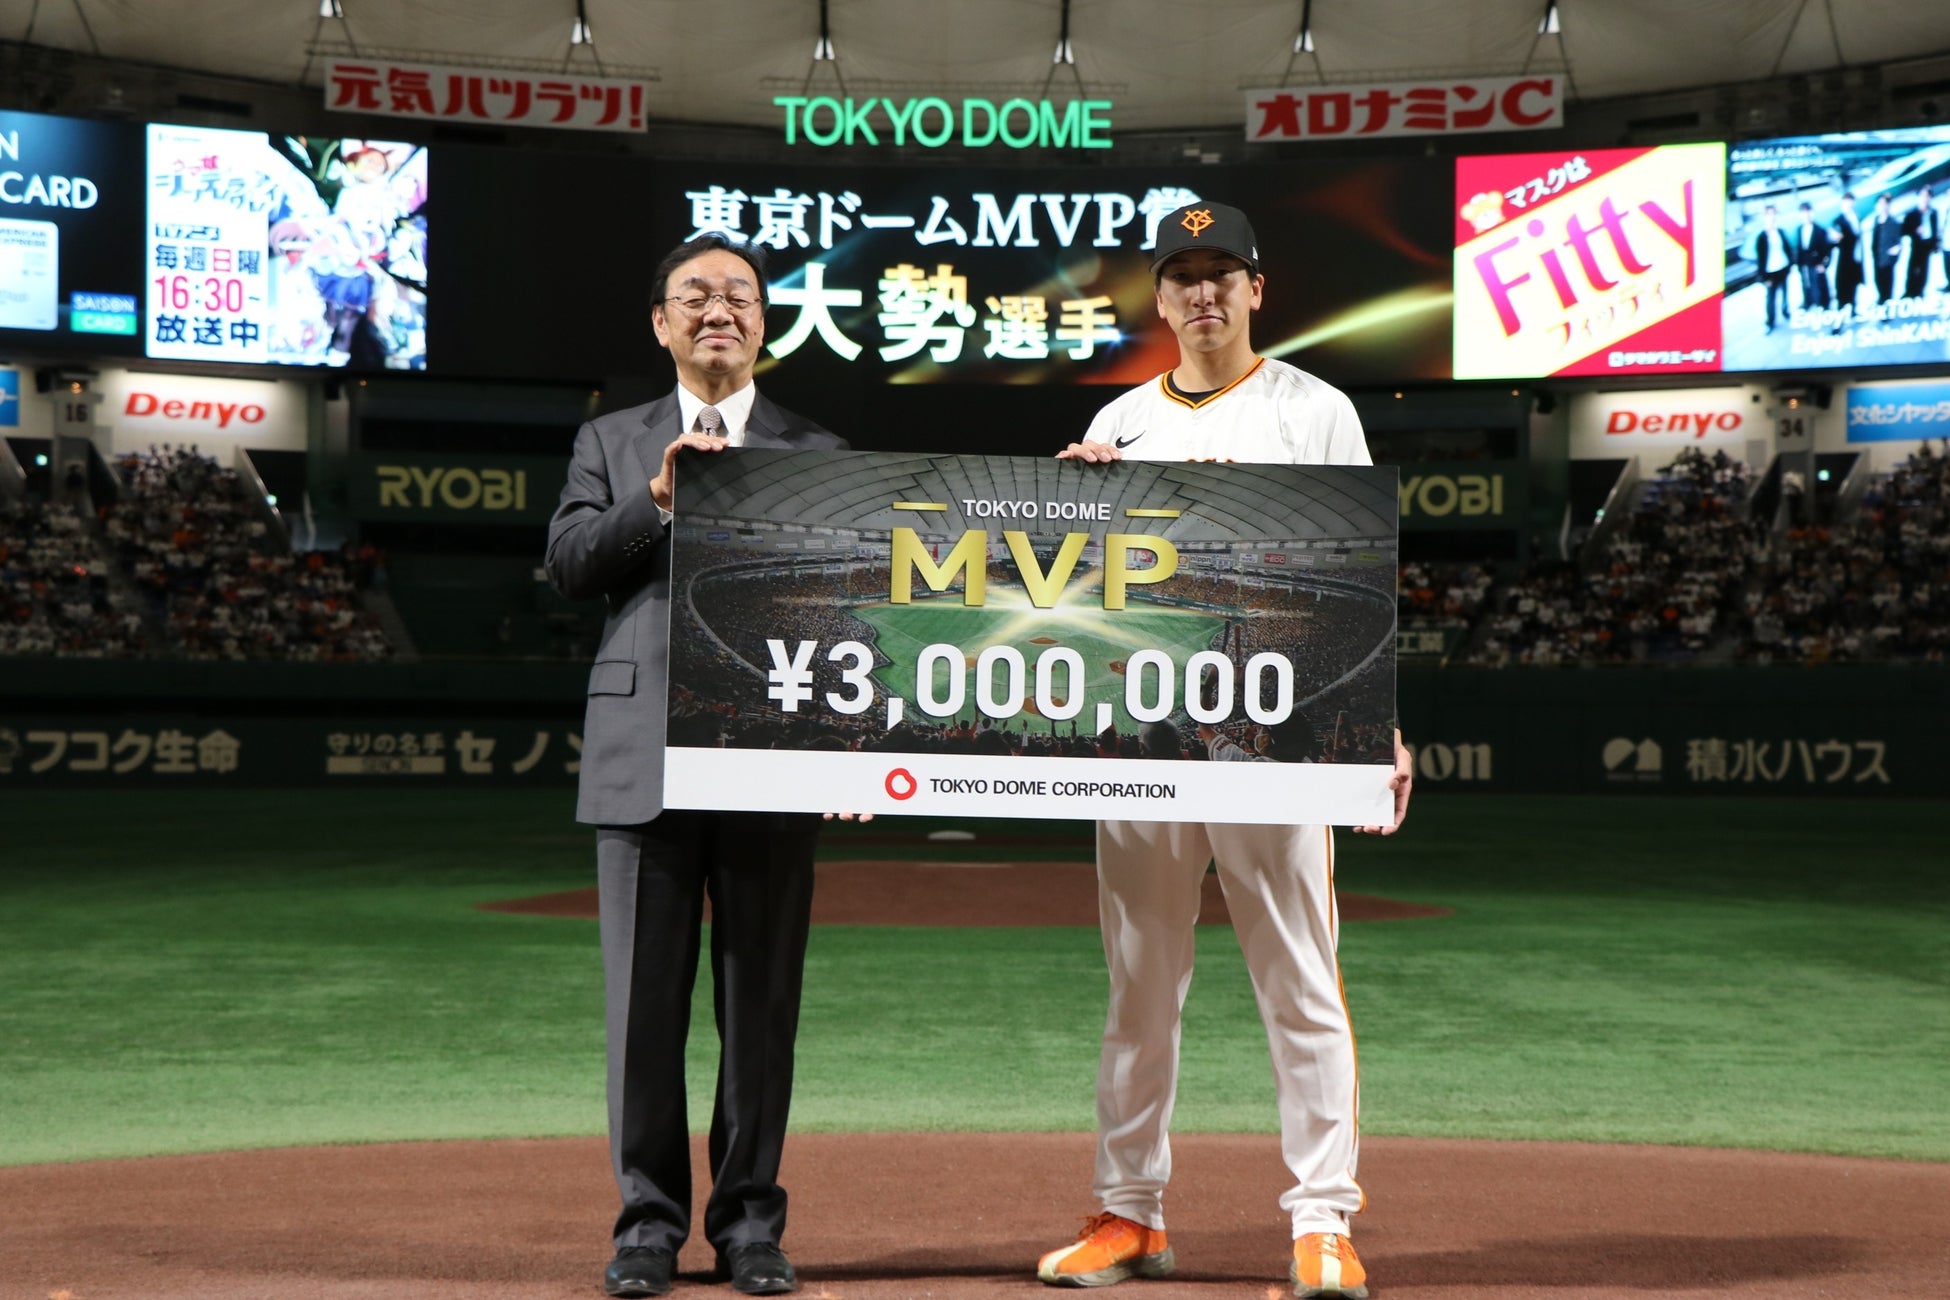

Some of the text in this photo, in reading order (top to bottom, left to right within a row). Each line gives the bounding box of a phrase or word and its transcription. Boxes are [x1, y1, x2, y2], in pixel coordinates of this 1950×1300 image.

[330, 64, 645, 128] 元気ハツラツ!
[1255, 79, 1556, 138] オロナミンC
[774, 96, 1113, 149] TOKYO DOME
[0, 171, 99, 209] CARD
[1504, 155, 1593, 208] マスクは
[155, 243, 261, 275] 毎週日曜
[1474, 179, 1695, 337] Fitty
[155, 313, 259, 348] 放送中
[125, 392, 266, 428] Denyo
[1606, 408, 1743, 438] Denyo
[376, 466, 526, 510] RYOBI
[962, 498, 1112, 521] TOKYO DOME
[890, 527, 1180, 611] MVP
[767, 638, 1294, 734] ¥3,000,000
[27, 729, 241, 774] フコク生命
[1411, 743, 1492, 781] on
[1686, 737, 1890, 783] 積水ハウス
[930, 778, 1176, 799] TOKYO DOME CORPORATION
